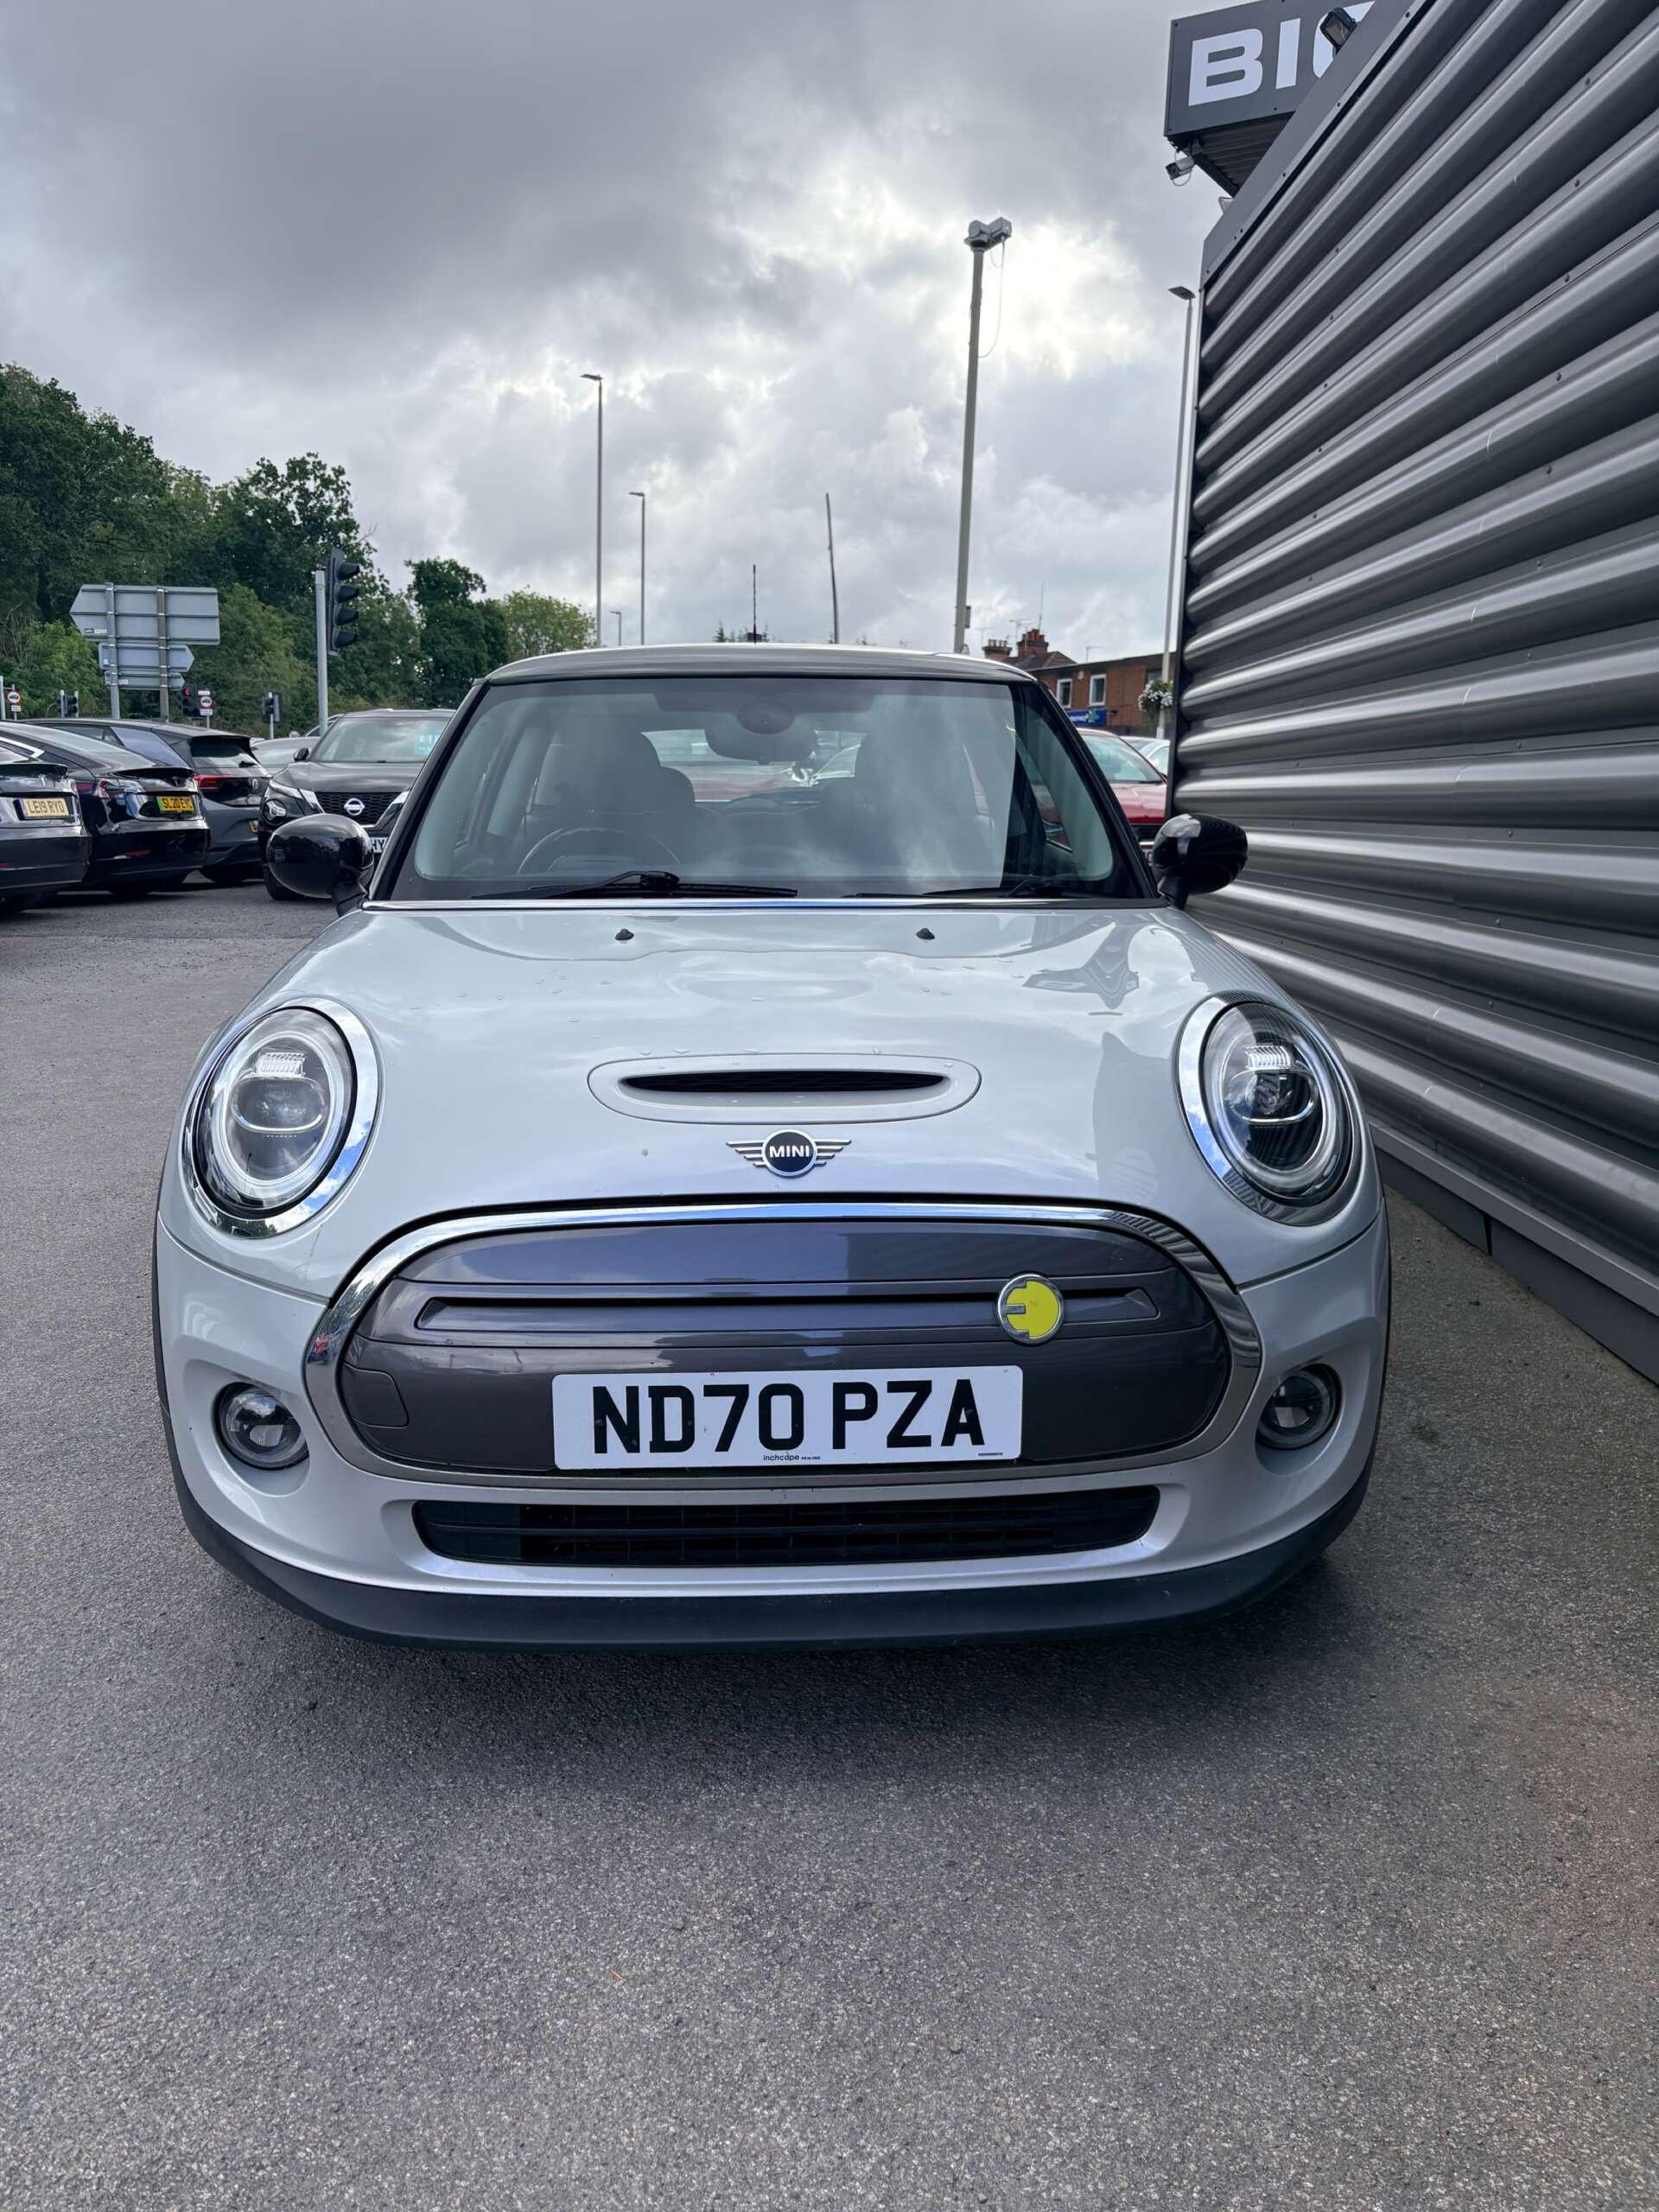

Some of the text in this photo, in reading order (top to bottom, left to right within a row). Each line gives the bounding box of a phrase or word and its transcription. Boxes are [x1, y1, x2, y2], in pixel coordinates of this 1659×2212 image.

[769, 1145, 810, 1158] MINI
[593, 1379, 985, 1454] ND70 PZA
